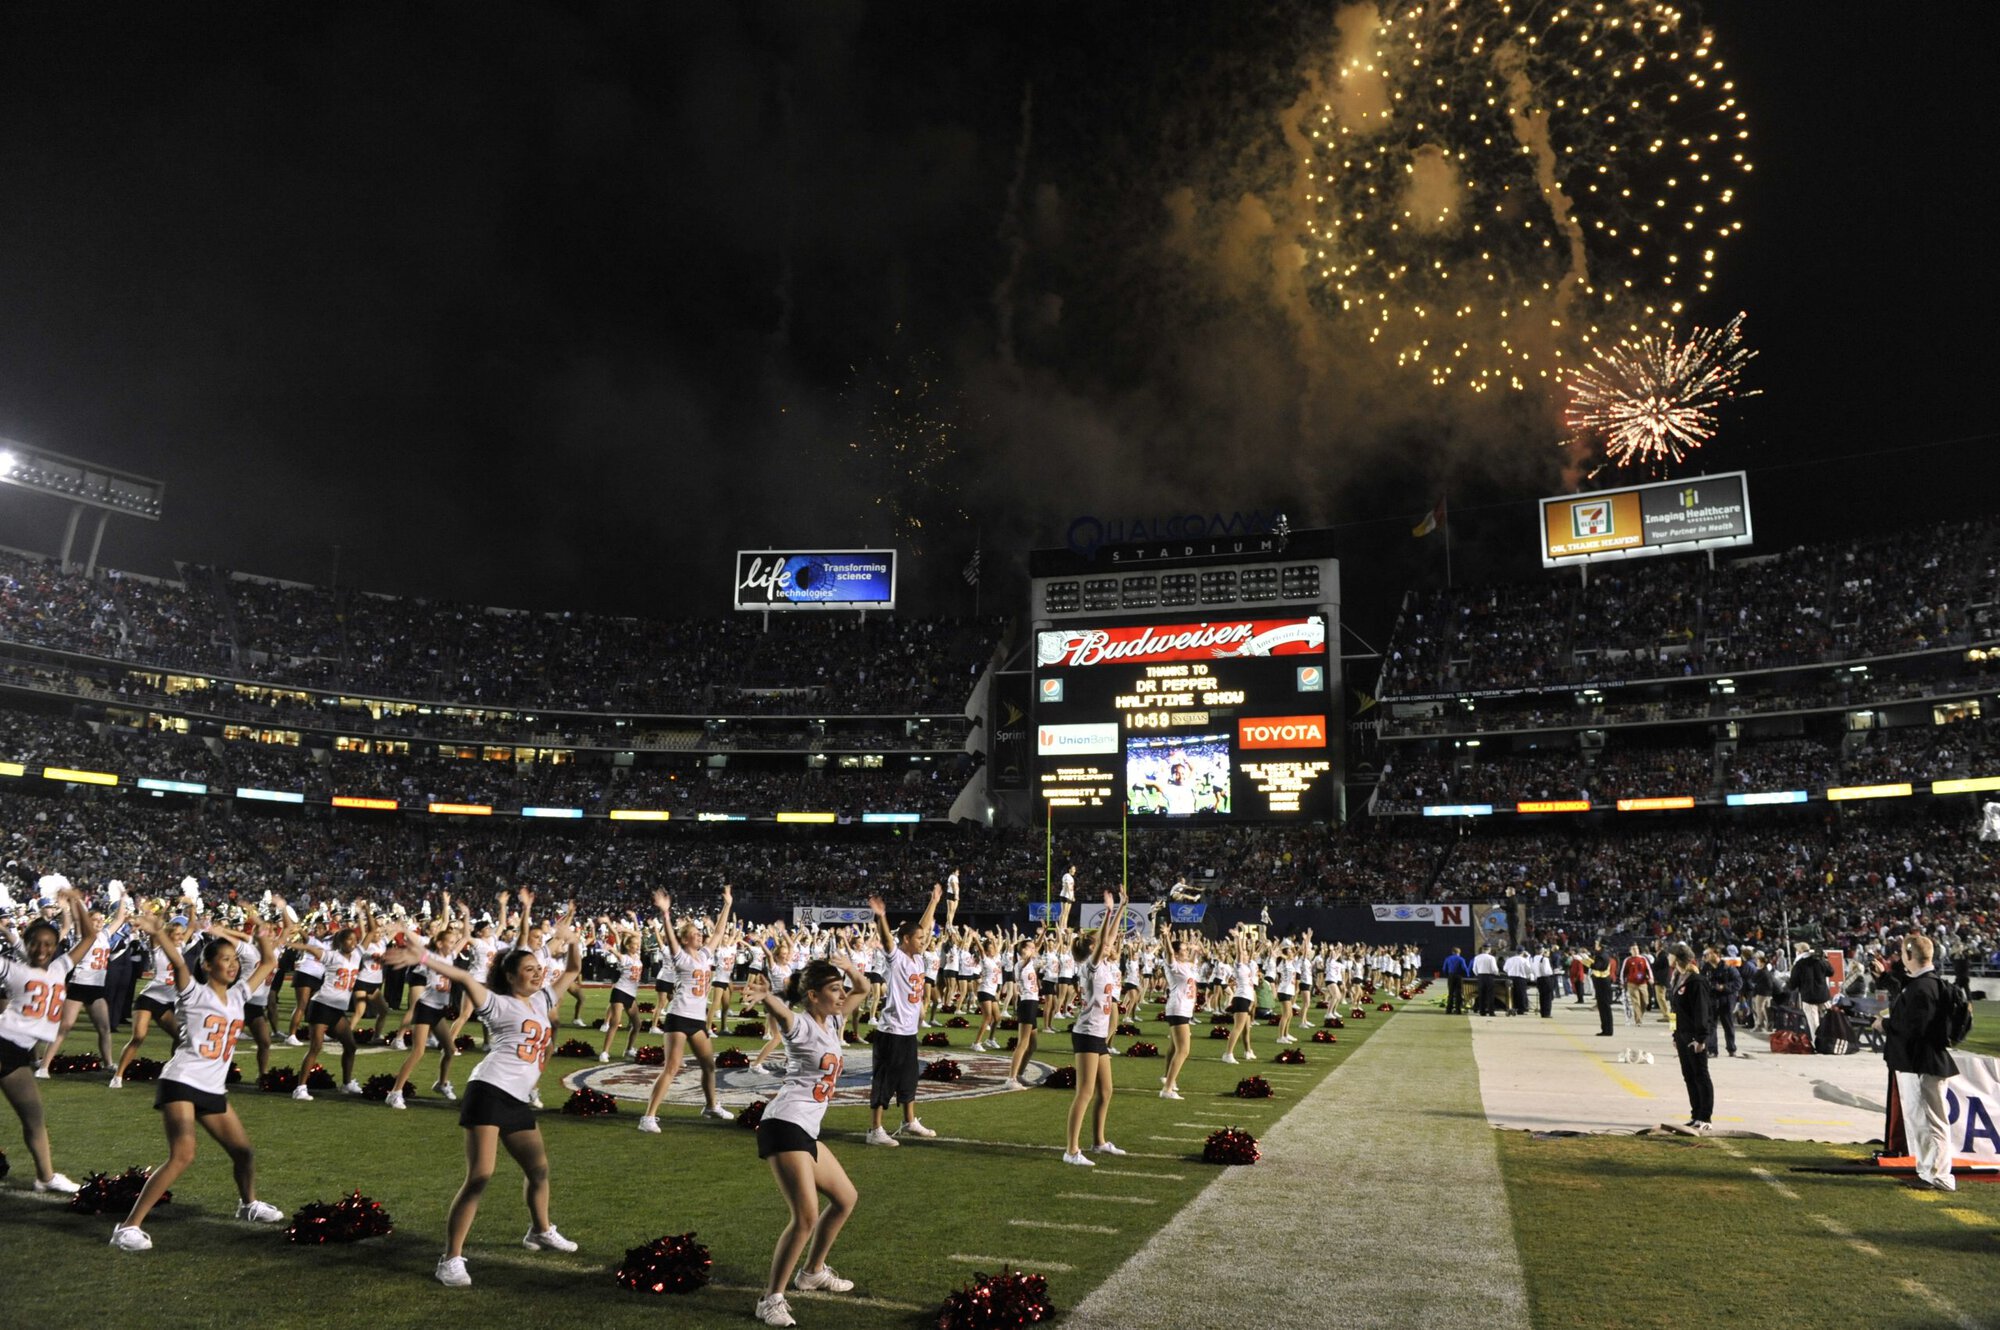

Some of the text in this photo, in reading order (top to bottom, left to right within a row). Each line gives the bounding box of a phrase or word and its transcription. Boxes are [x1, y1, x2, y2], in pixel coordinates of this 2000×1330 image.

[1645, 505, 1740, 524] Imaging Healthcare
[1581, 519, 1604, 528] ELEVEN
[1652, 522, 1733, 539] Your Partner in Health
[1112, 540, 1273, 561] STADIUM
[1567, 540, 1601, 551] THANK
[1601, 535, 1639, 547] HEAVEN!
[823, 563, 887, 573] Transforming
[837, 572, 872, 580] science
[740, 557, 792, 600] life
[1063, 623, 1253, 666] Budweiser
[1146, 665, 1208, 677] THANKS TO
[1136, 678, 1217, 693] DR PEPPER
[1116, 691, 1244, 708] HALFTIME SHOW
[996, 730, 1026, 744] Sprint
[1243, 724, 1322, 742] TOYOTA
[1441, 906, 1462, 925] N
[22, 980, 67, 1023] 36
